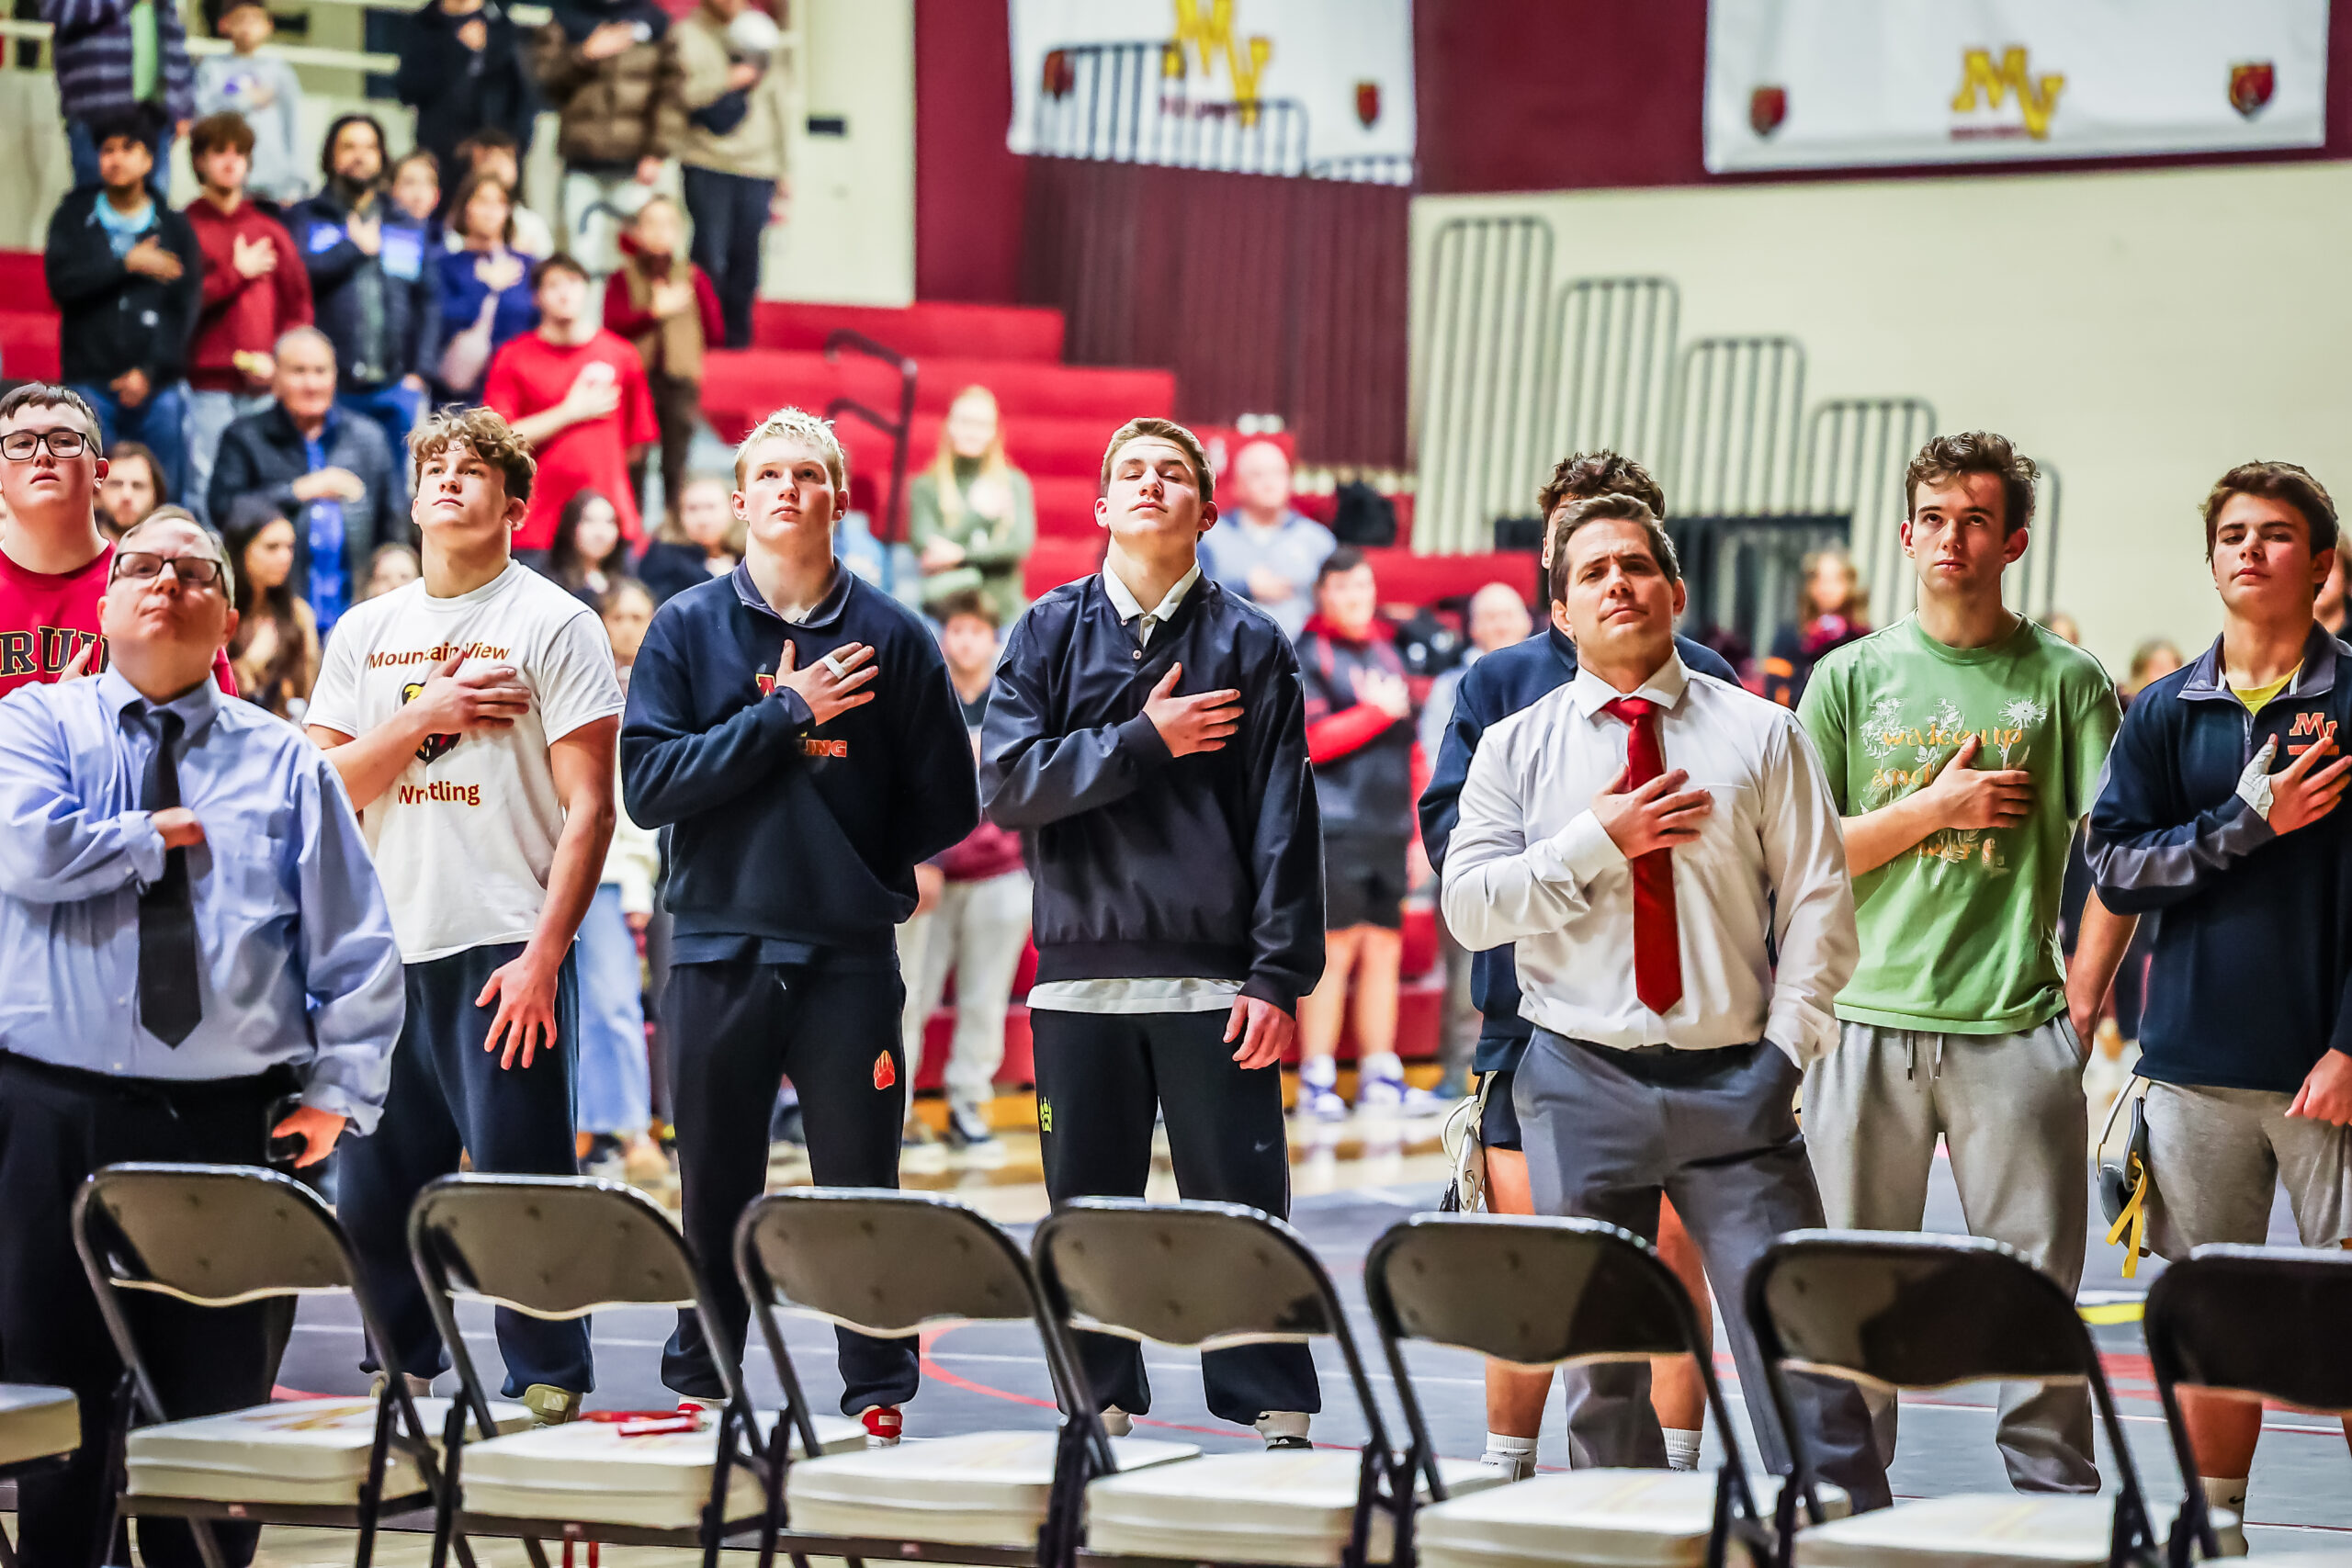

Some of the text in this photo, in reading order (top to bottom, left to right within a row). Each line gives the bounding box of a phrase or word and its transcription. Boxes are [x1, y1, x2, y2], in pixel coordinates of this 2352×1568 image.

[1951, 47, 2064, 141] MV
[0, 626, 109, 677] RUI
[368, 641, 510, 671] Mounain View
[2289, 712, 2338, 740] MV
[1871, 762, 1932, 786] and
